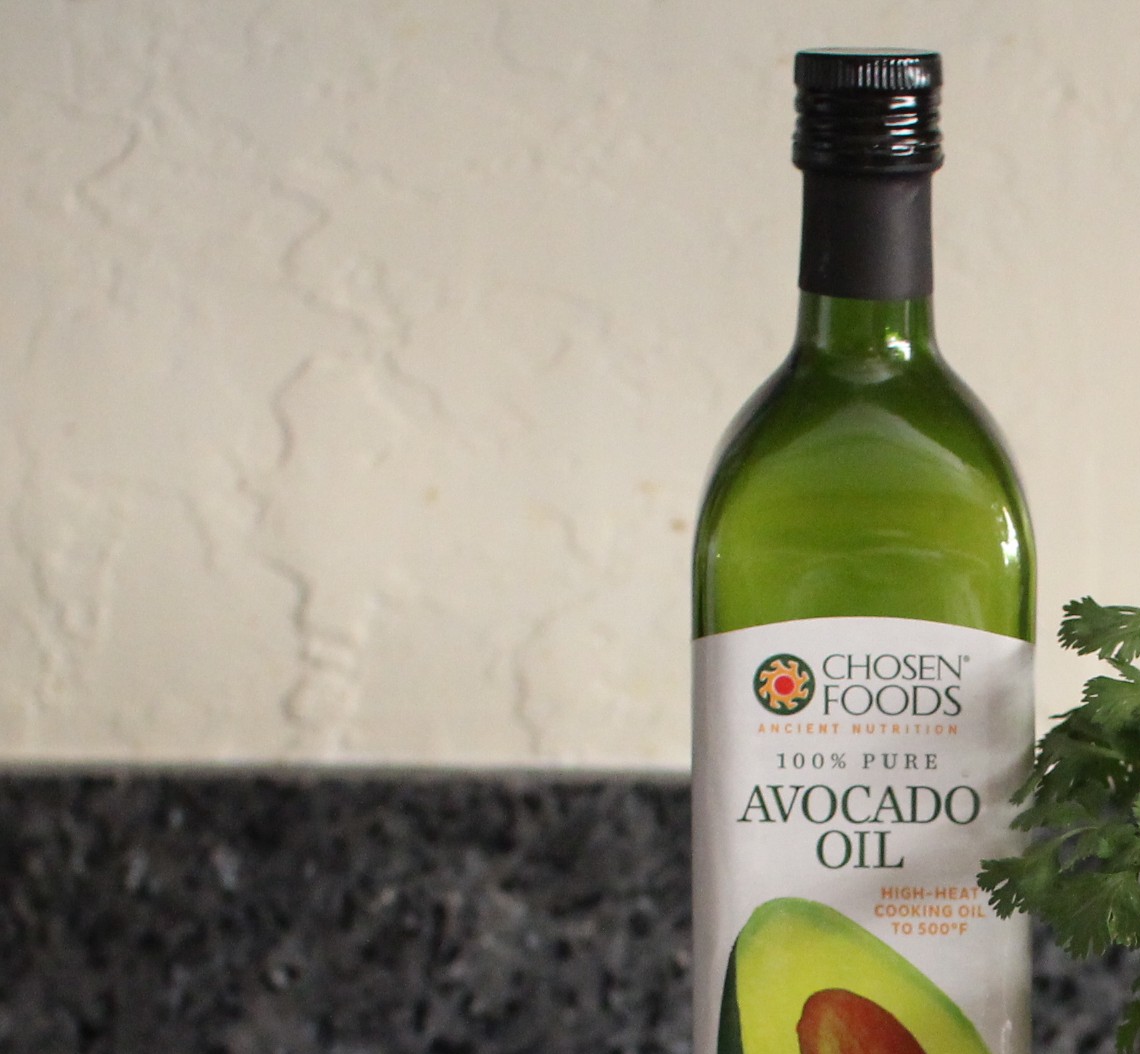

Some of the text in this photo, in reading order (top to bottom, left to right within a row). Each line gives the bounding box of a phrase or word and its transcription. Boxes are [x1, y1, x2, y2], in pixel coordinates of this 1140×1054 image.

[823, 685, 962, 716] FOODS
[758, 723, 960, 735] ANCIENT NUTRITION
[776, 752, 938, 770] 100% PURE
[737, 784, 981, 825] AVOCADO
[815, 829, 904, 870] OIL
[880, 886, 980, 900] HIGH-HEAT
[874, 904, 987, 918] COOKING OIL
[891, 922, 968, 935] TO 500°F
